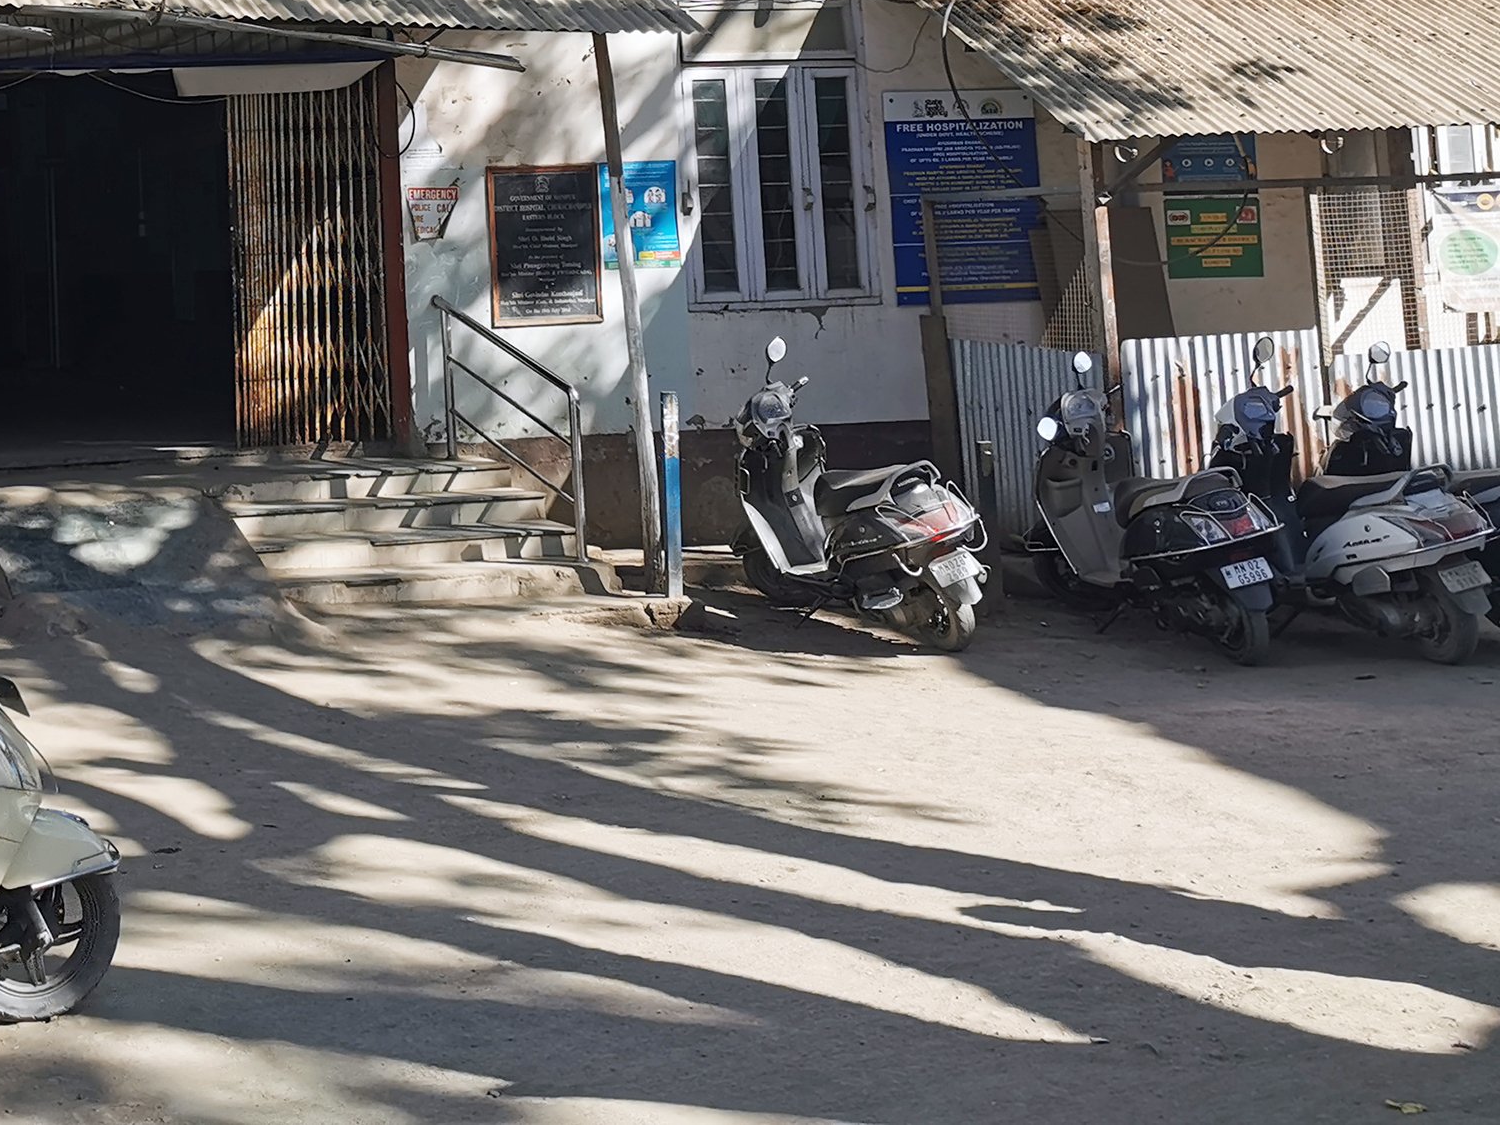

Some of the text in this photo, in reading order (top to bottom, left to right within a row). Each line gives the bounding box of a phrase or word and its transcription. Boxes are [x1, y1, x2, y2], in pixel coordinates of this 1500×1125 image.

[896, 121, 1023, 132] FREE HOSPITALIZATION
[408, 189, 457, 200] EMERGENCY
